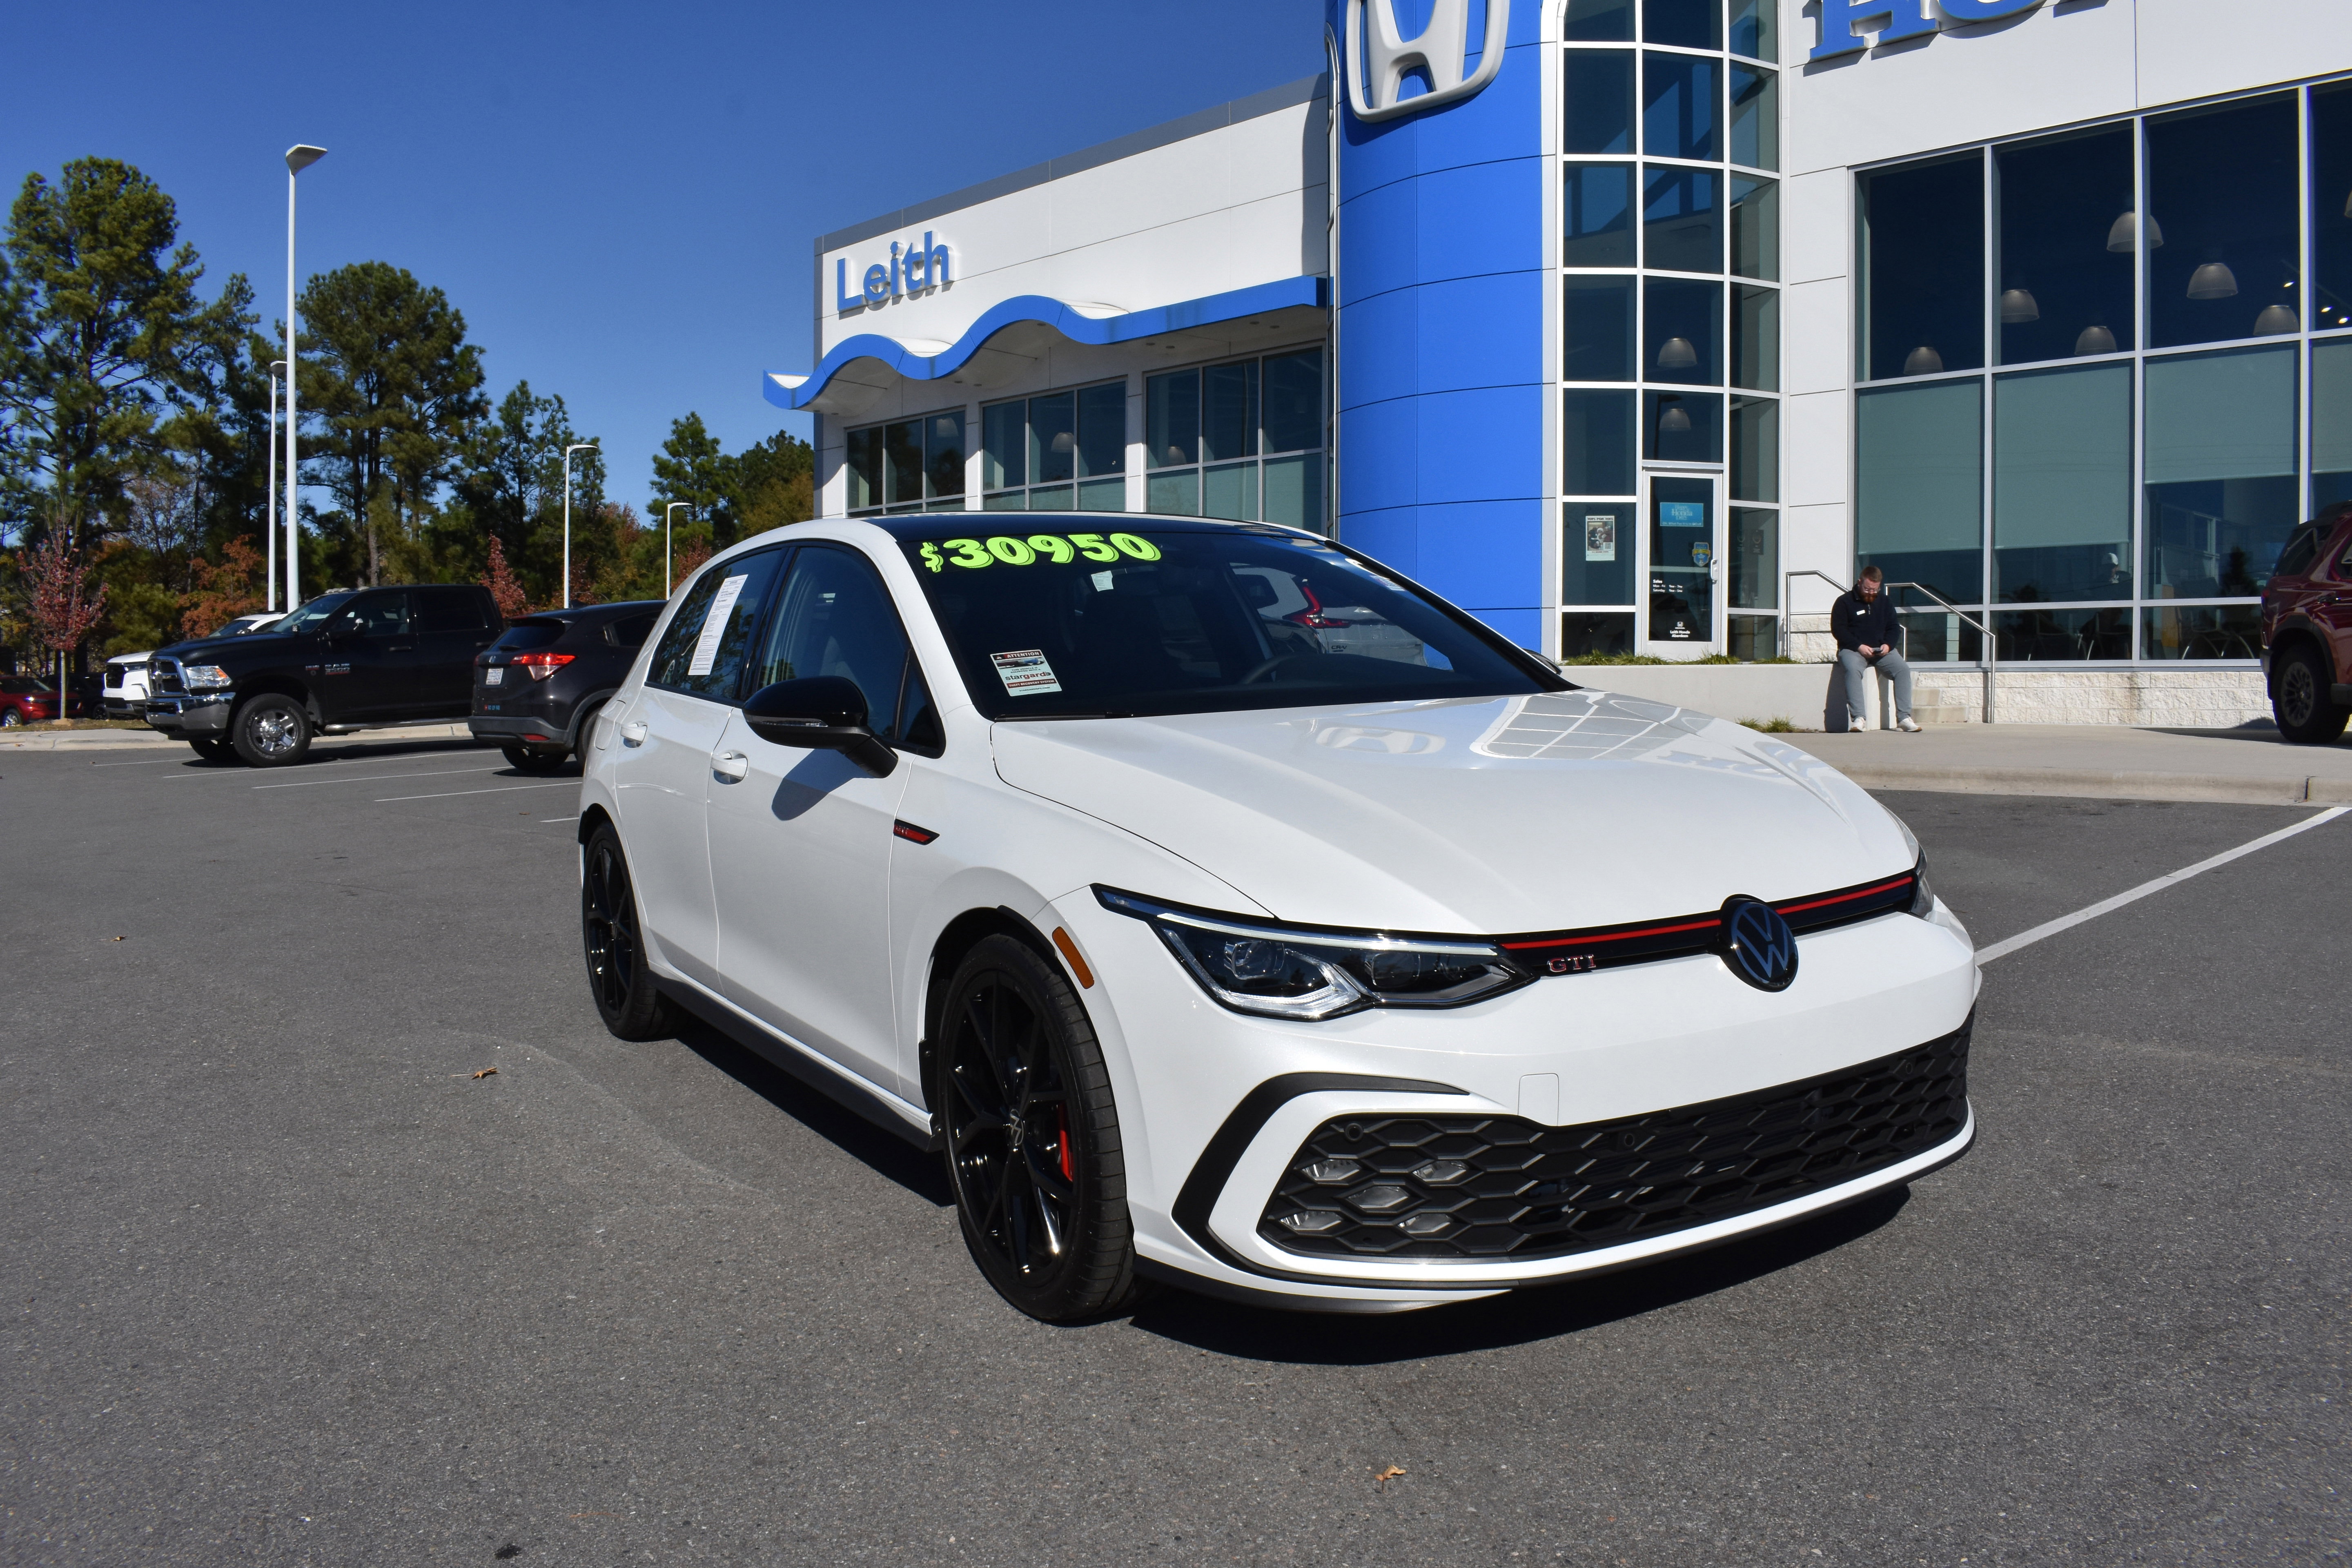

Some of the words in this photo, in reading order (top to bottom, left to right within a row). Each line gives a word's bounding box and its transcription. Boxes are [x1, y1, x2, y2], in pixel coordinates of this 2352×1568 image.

[837, 230, 951, 312] Leith
[920, 533, 1161, 572] $30950
[1547, 954, 1596, 972] GTI
